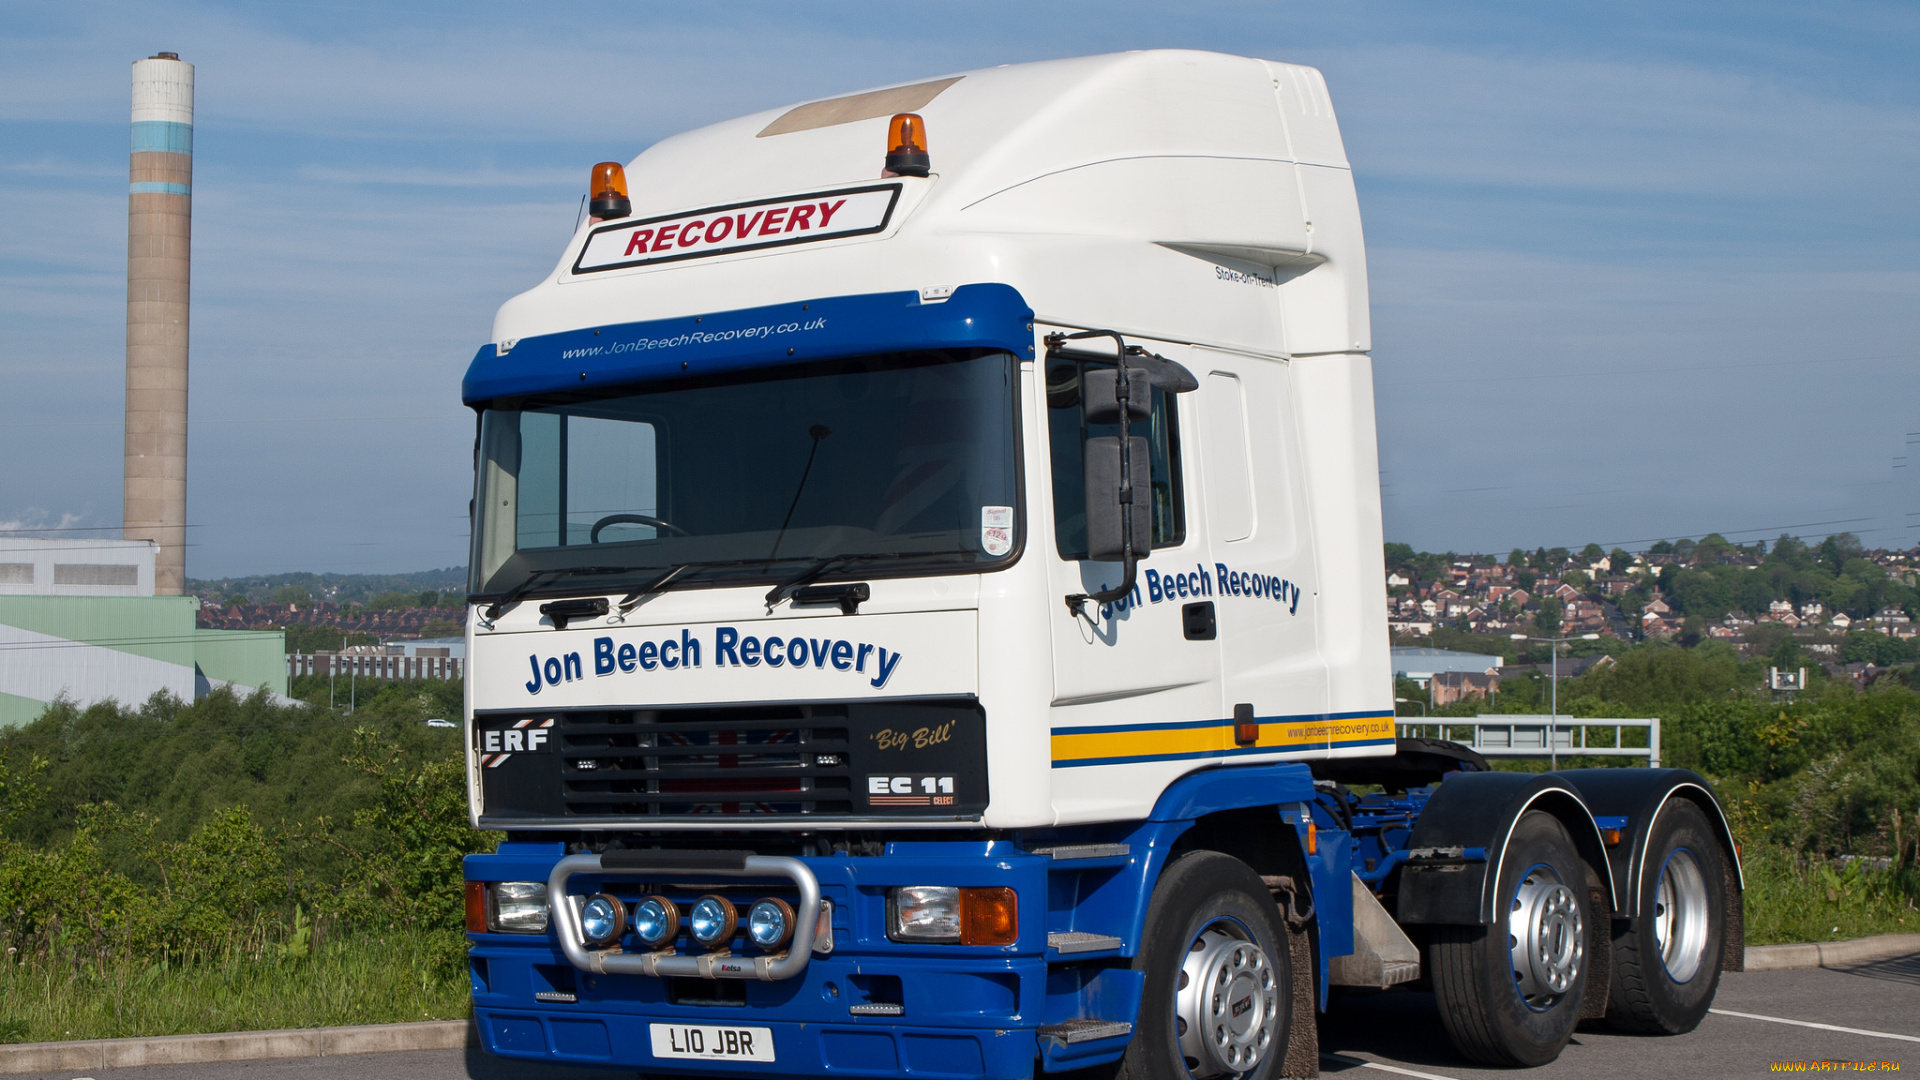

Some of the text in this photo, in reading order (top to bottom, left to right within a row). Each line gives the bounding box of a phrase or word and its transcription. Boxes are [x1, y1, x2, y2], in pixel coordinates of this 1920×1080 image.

[623, 199, 847, 257] RECOVERY
[1215, 266, 1273, 289] Stoke-on-Trent
[562, 316, 827, 360] www.JonBeechRecovery.co.uk
[1144, 563, 1213, 605] Beech
[1215, 562, 1301, 616] Recovery
[525, 626, 903, 695] Jon Beech Recovery
[485, 729, 549, 752] ERF
[868, 776, 954, 794] EC 11
[669, 1028, 755, 1056] L10 JBR
